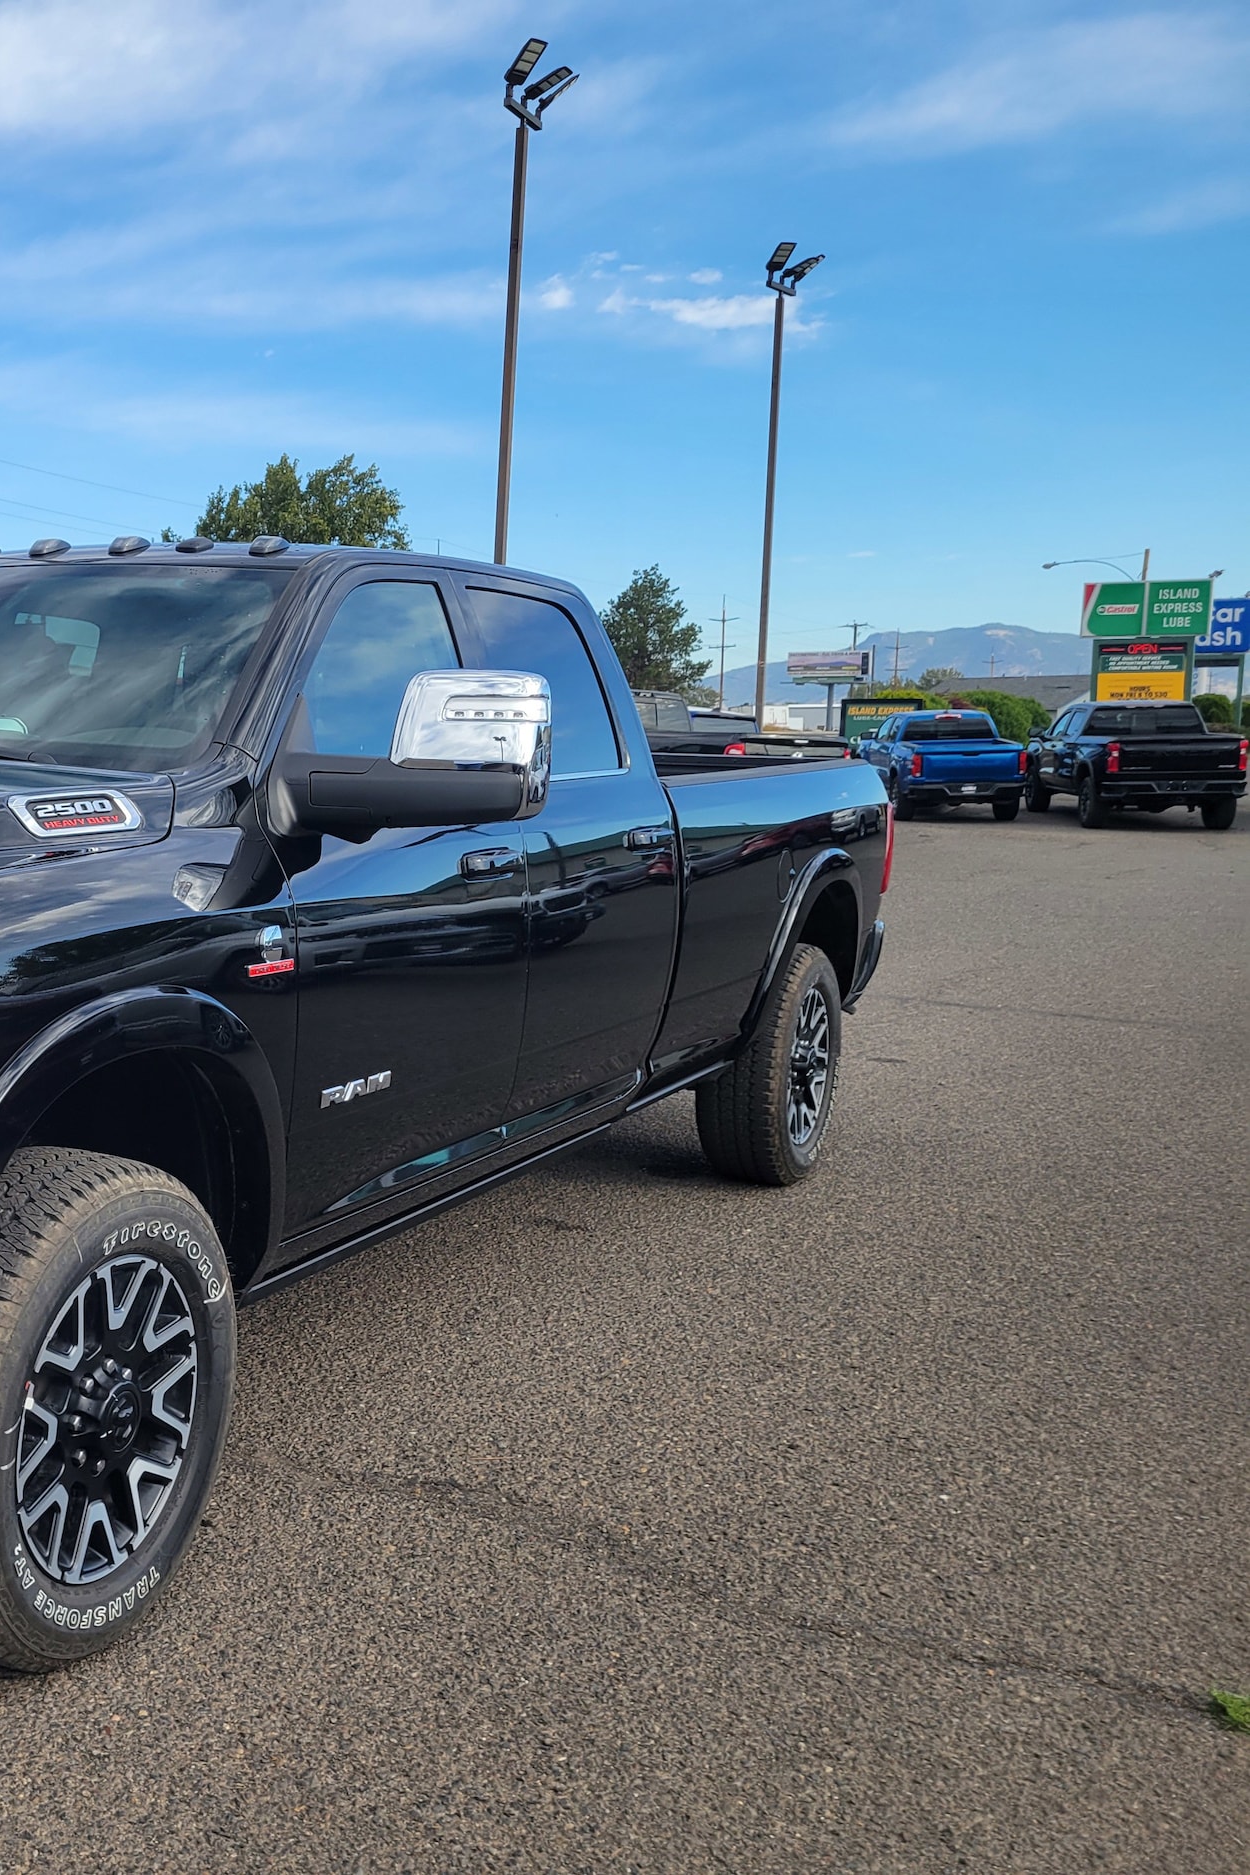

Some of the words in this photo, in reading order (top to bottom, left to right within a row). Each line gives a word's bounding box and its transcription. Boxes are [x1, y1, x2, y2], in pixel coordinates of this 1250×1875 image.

[1158, 588, 1200, 599] ISLAND
[1106, 605, 1136, 614] Castrol
[1153, 602, 1203, 614] EXPRESS
[1212, 607, 1245, 623] ar
[1162, 616, 1191, 628] LUBE
[1194, 626, 1242, 647] ash
[1127, 643, 1158, 654] OPEN
[847, 706, 877, 716] ISLAND
[33, 799, 113, 819] 2500
[44, 818, 85, 830] HEAVY
[86, 815, 120, 825] DUTY
[319, 1070, 392, 1109] RAM
[103, 1220, 228, 1304] Firestone
[34, 1566, 161, 1630] TRANSFORCE
